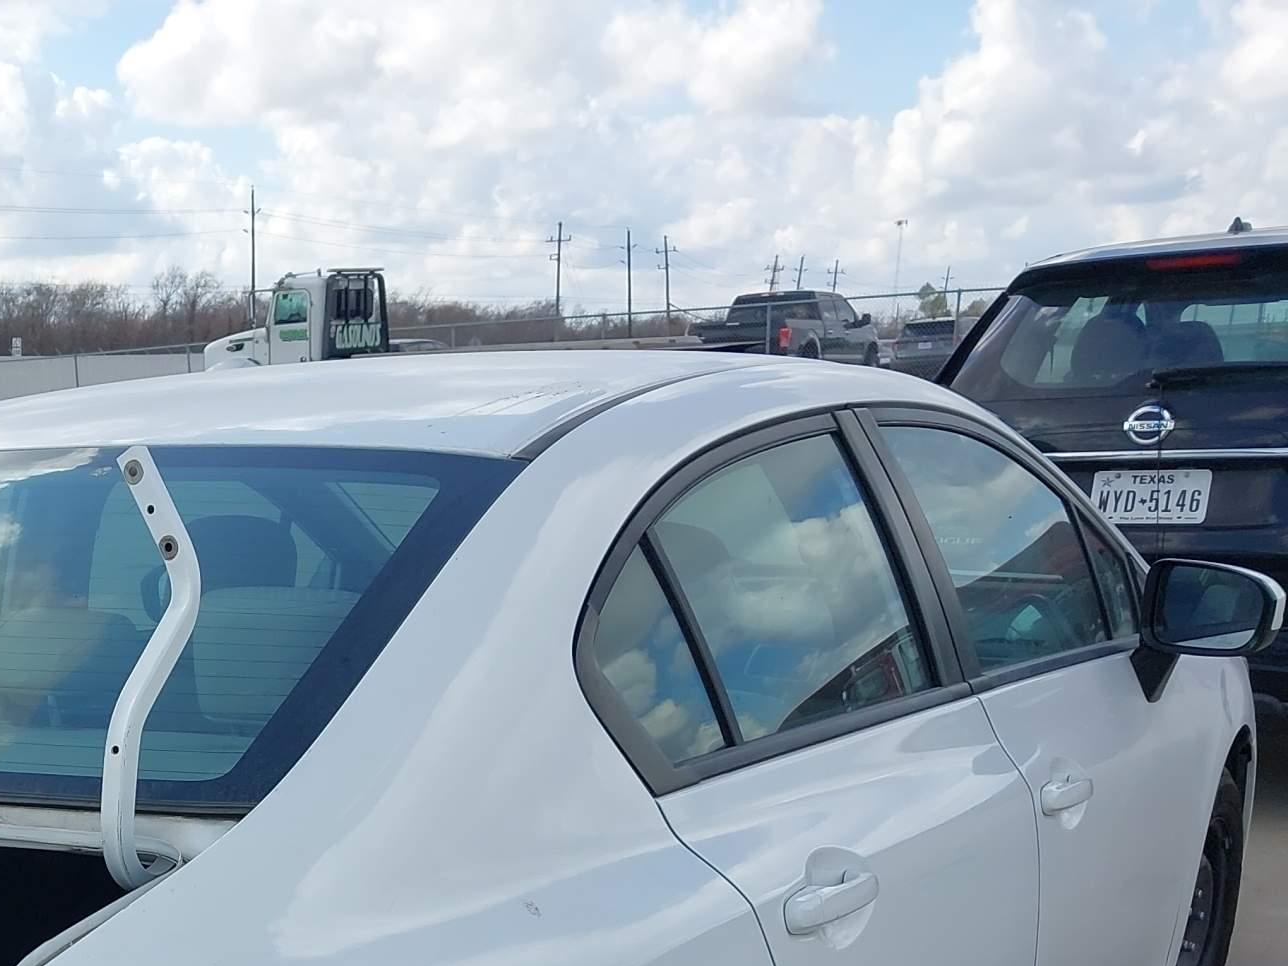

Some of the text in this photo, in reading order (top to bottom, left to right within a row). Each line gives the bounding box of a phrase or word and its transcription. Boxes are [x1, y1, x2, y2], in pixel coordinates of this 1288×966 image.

[1132, 474, 1175, 484] TEXAS
[1098, 489, 1202, 513] WYD 5146
